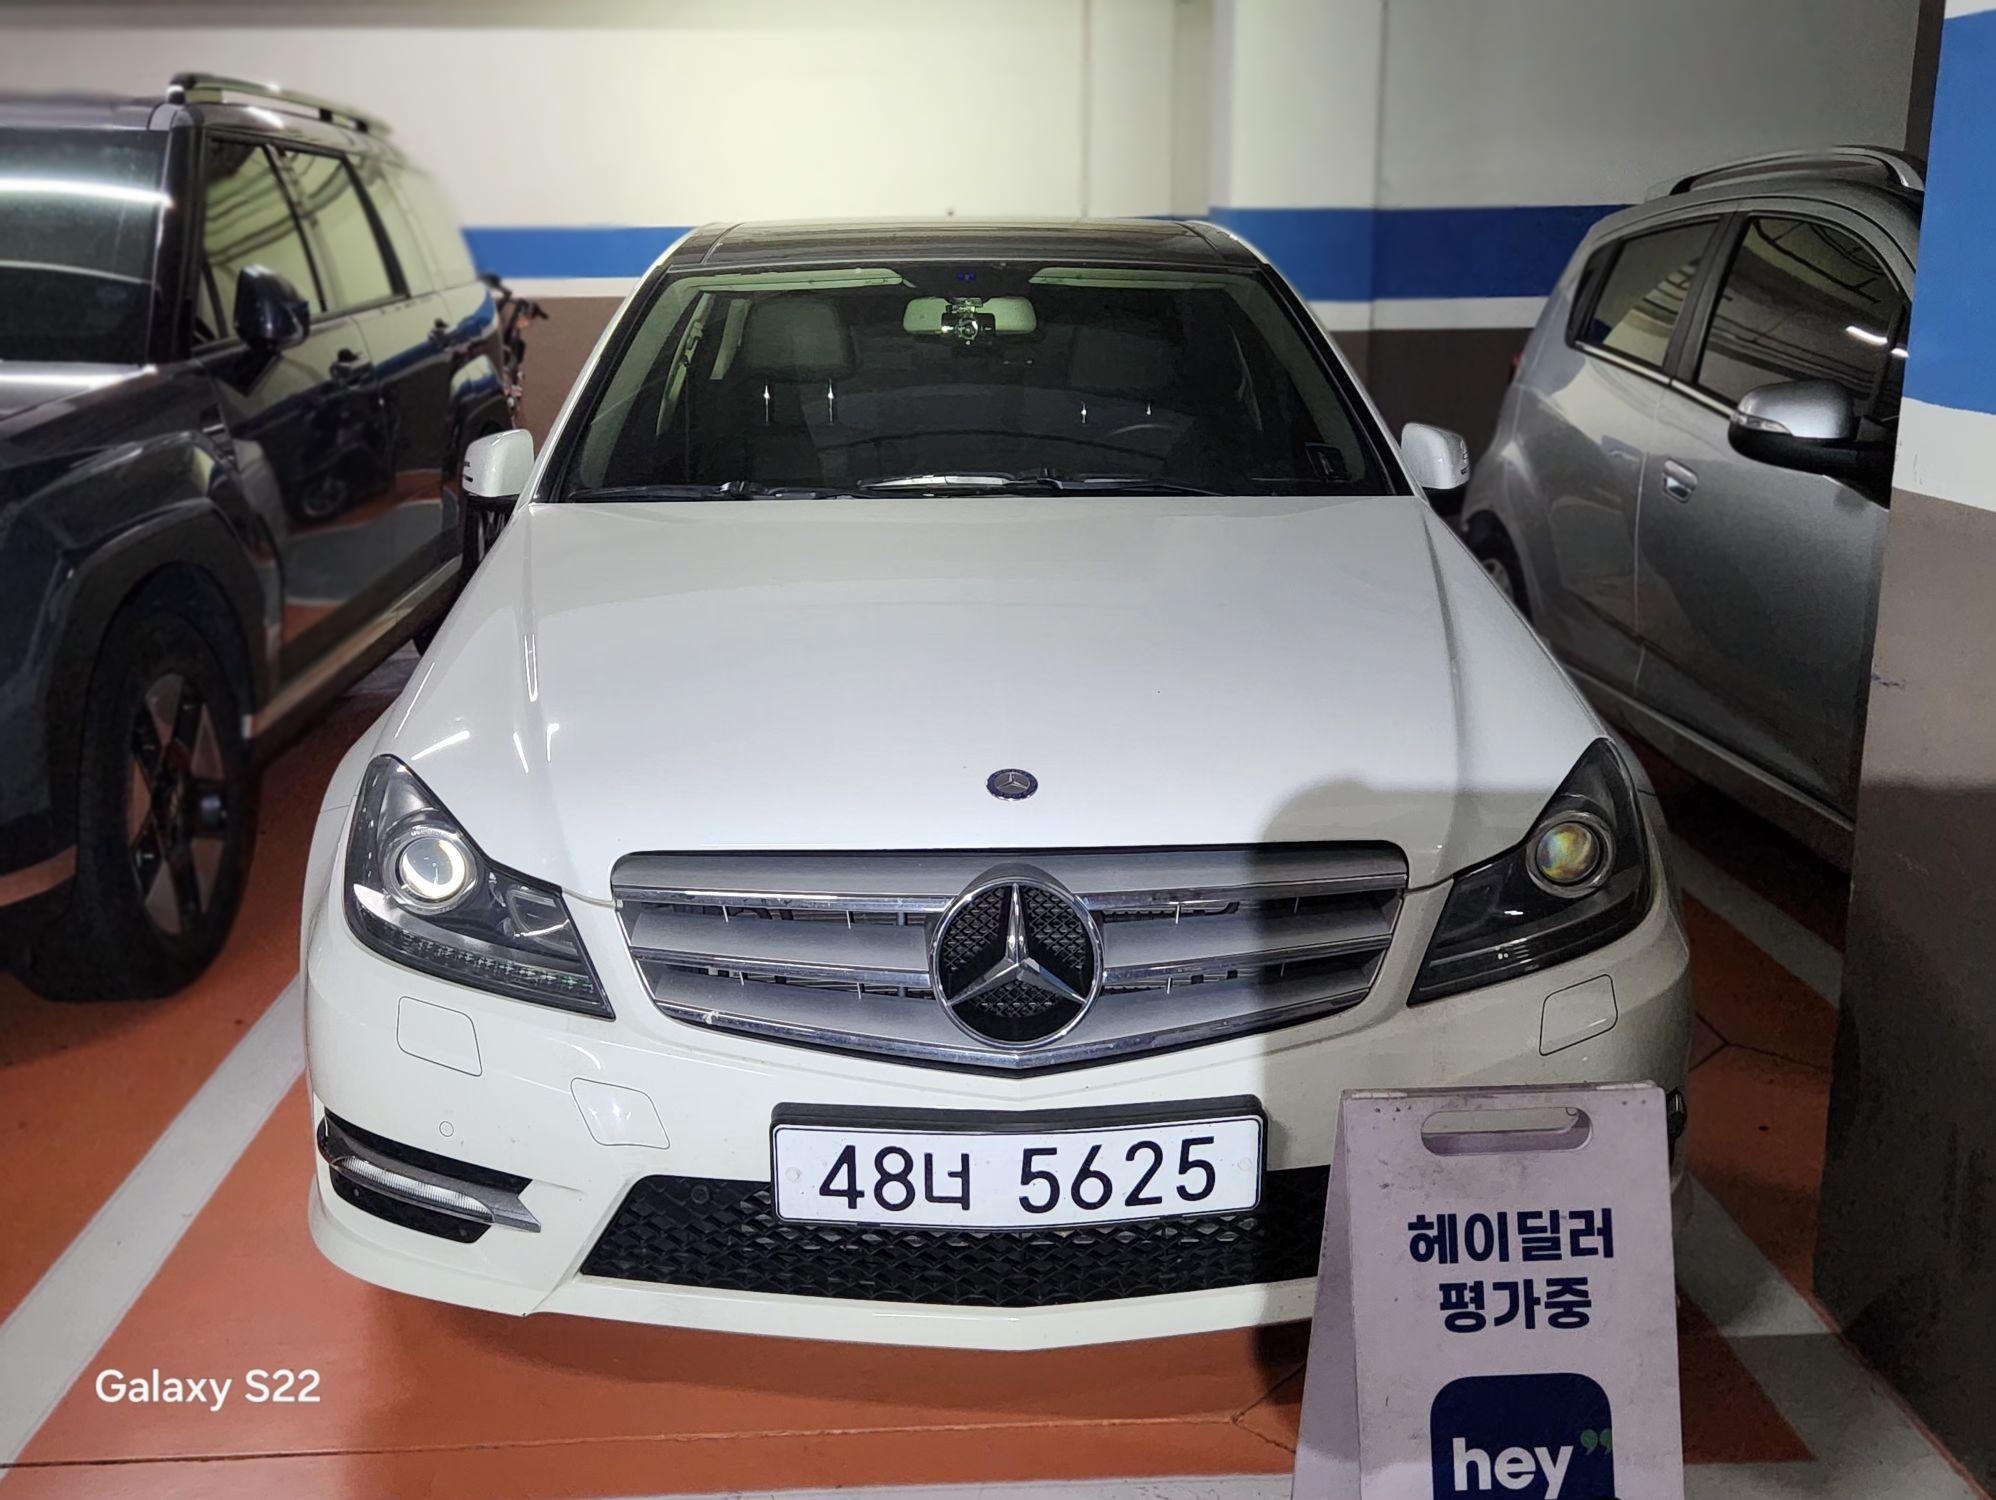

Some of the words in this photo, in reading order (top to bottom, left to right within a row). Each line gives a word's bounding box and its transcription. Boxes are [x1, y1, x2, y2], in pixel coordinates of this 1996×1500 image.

[819, 1144, 970, 1211] 48너
[1018, 1136, 1216, 1213] 5625
[1407, 1208, 1615, 1264] 헤이딜러
[1438, 1277, 1593, 1333] 평가중
